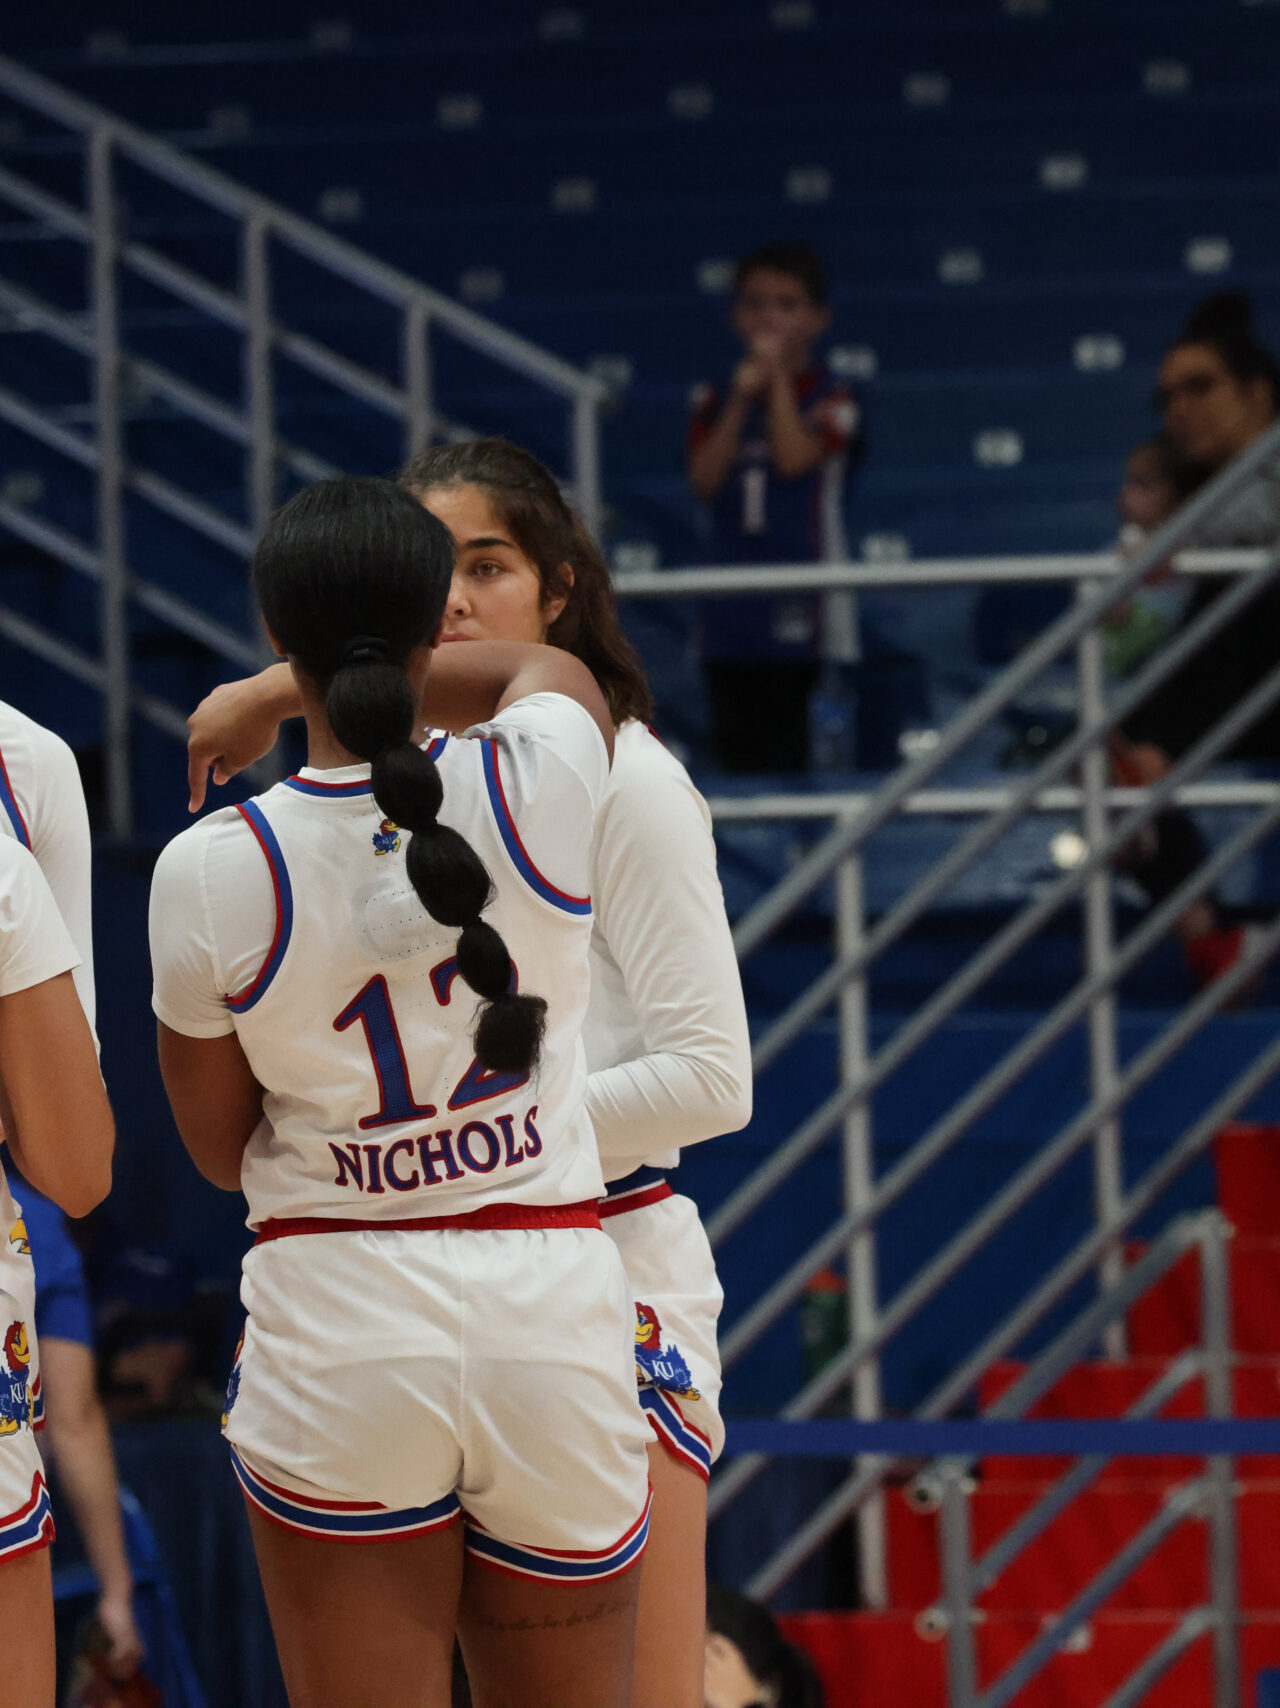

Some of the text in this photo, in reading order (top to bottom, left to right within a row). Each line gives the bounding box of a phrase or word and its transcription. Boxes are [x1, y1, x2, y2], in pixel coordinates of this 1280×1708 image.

[328, 1105, 543, 1193] NICHOLS
[652, 1360, 674, 1381] KU
[10, 1383, 25, 1404] KU
